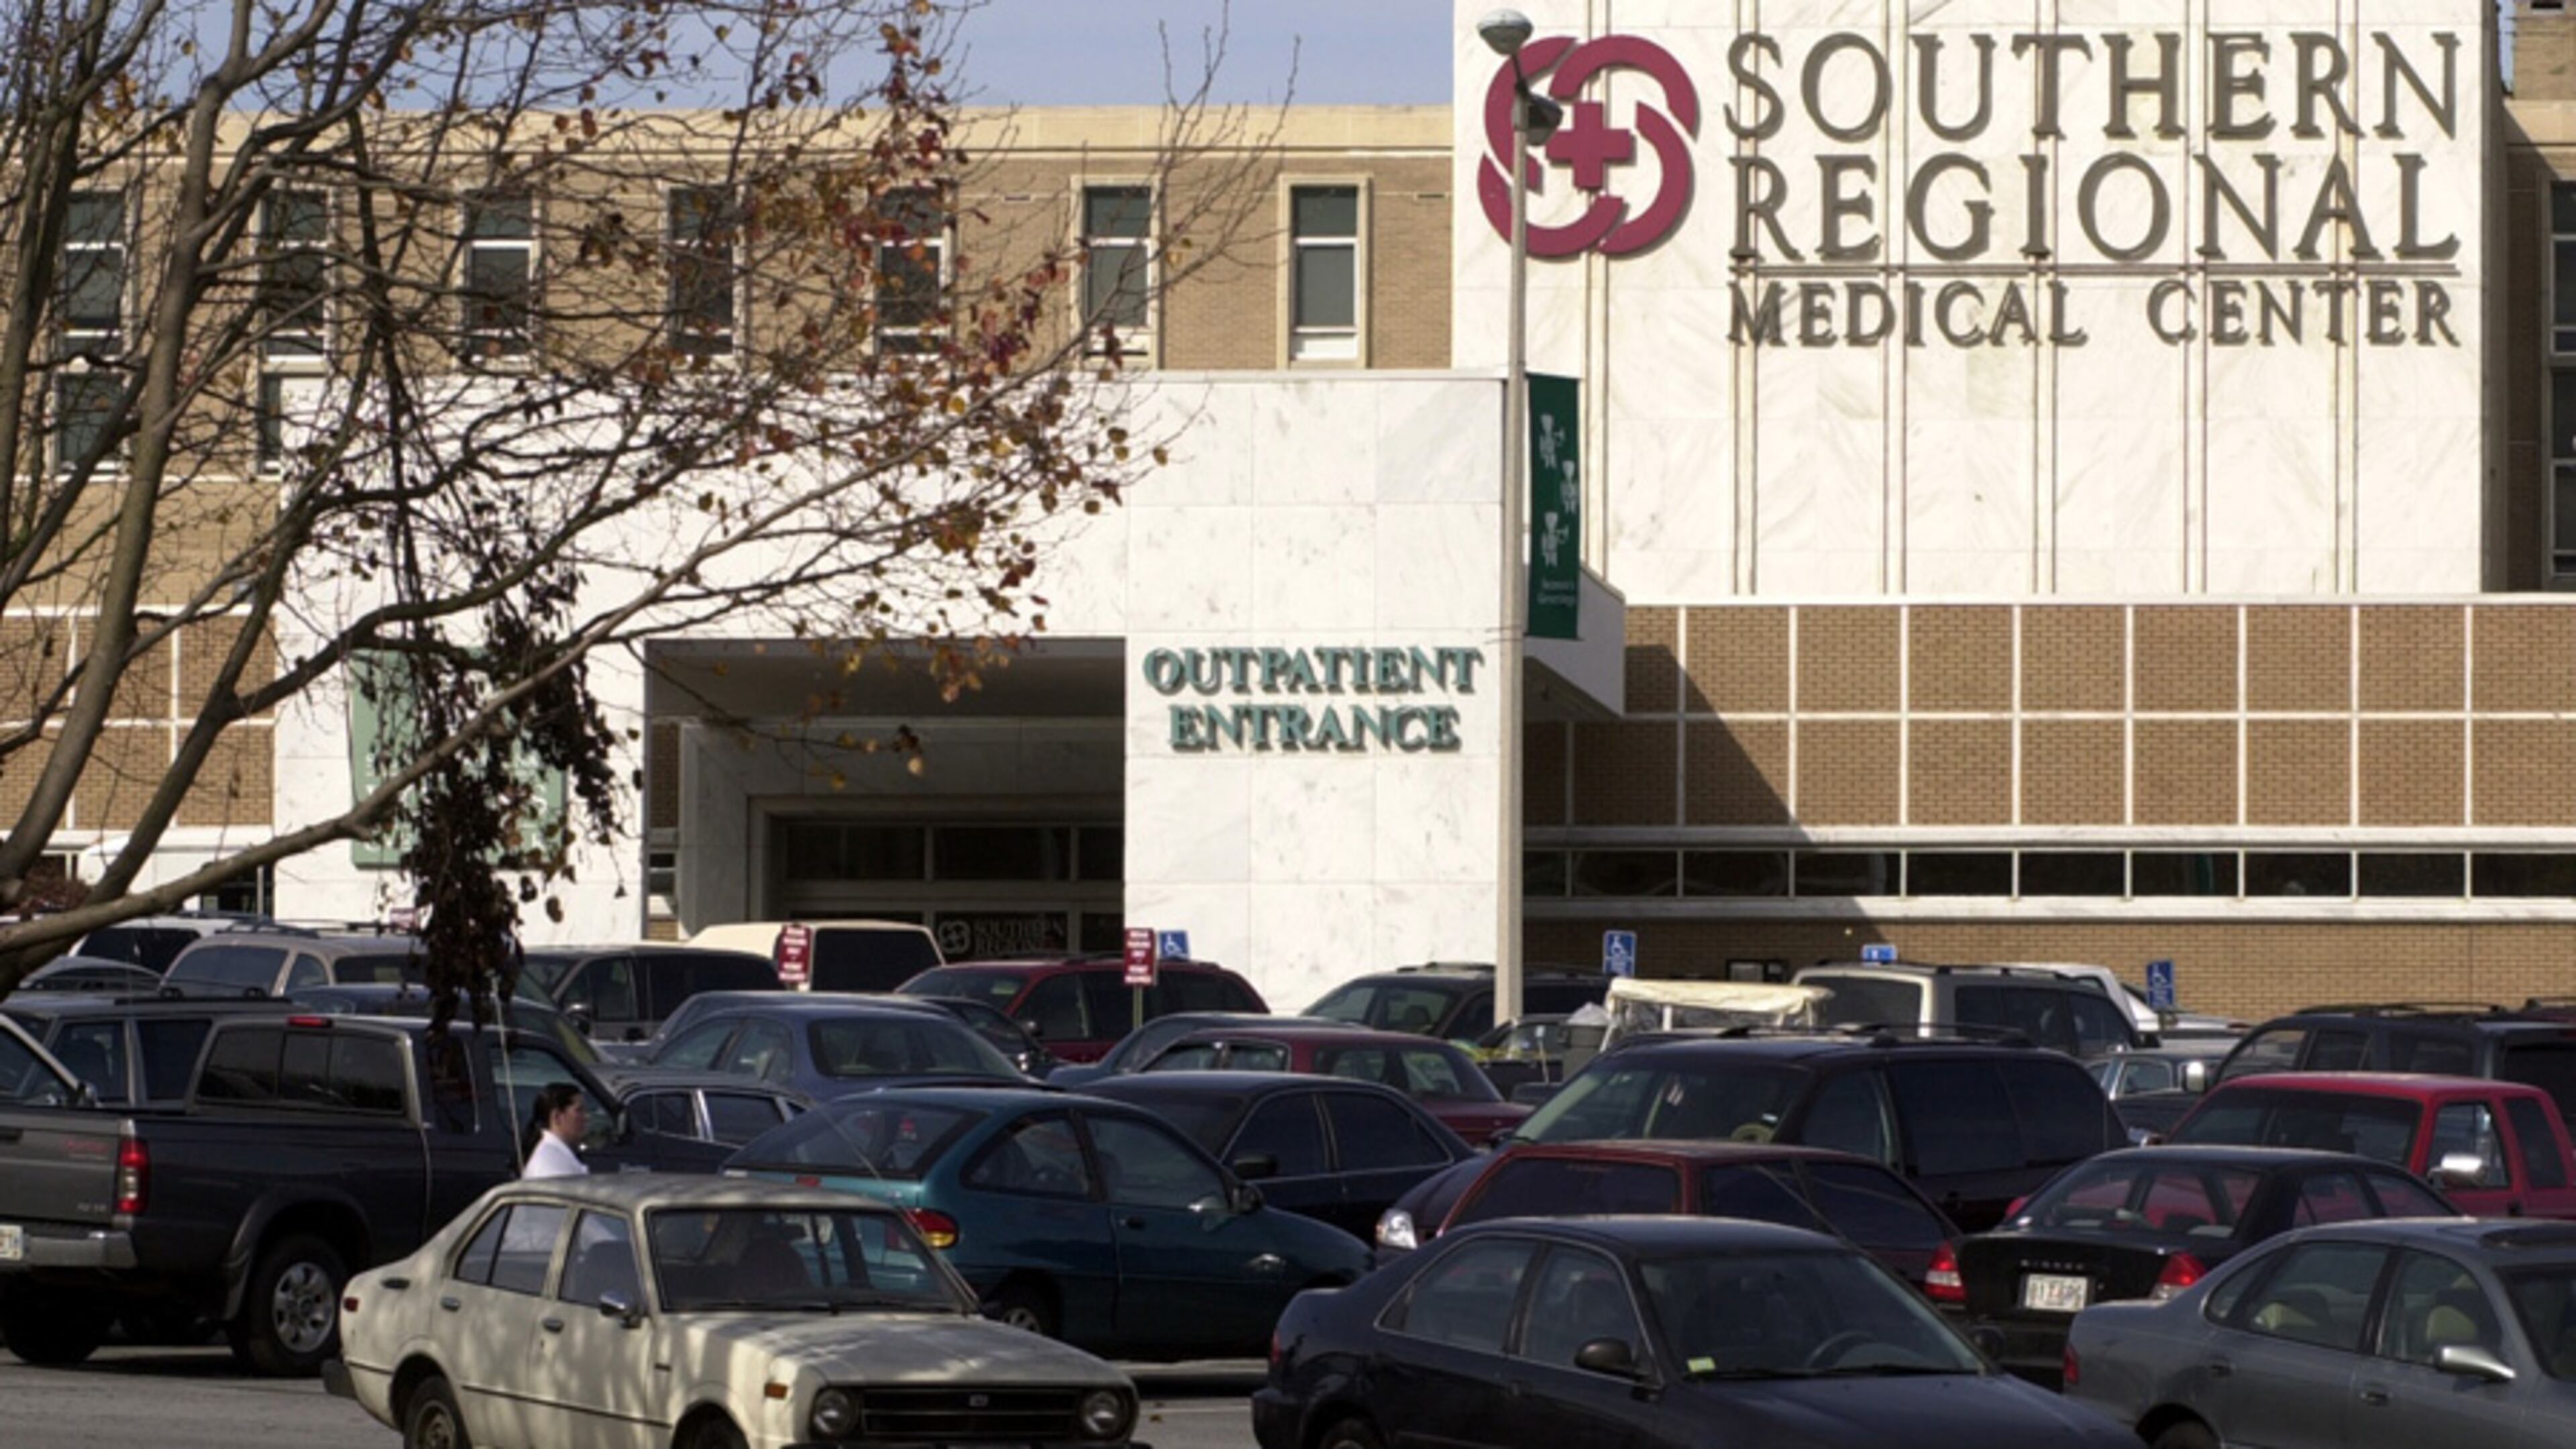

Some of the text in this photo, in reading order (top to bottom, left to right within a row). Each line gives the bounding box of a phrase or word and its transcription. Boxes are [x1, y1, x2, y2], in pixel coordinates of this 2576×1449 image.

[1724, 32, 2459, 142] SOUTHERN
[1727, 152, 2459, 262] REGIONAL
[1727, 280, 2460, 347] MEDICAL CENTER
[1142, 647, 1485, 696] OUTPATIENT
[1169, 704, 1461, 753] ENTRANCE
